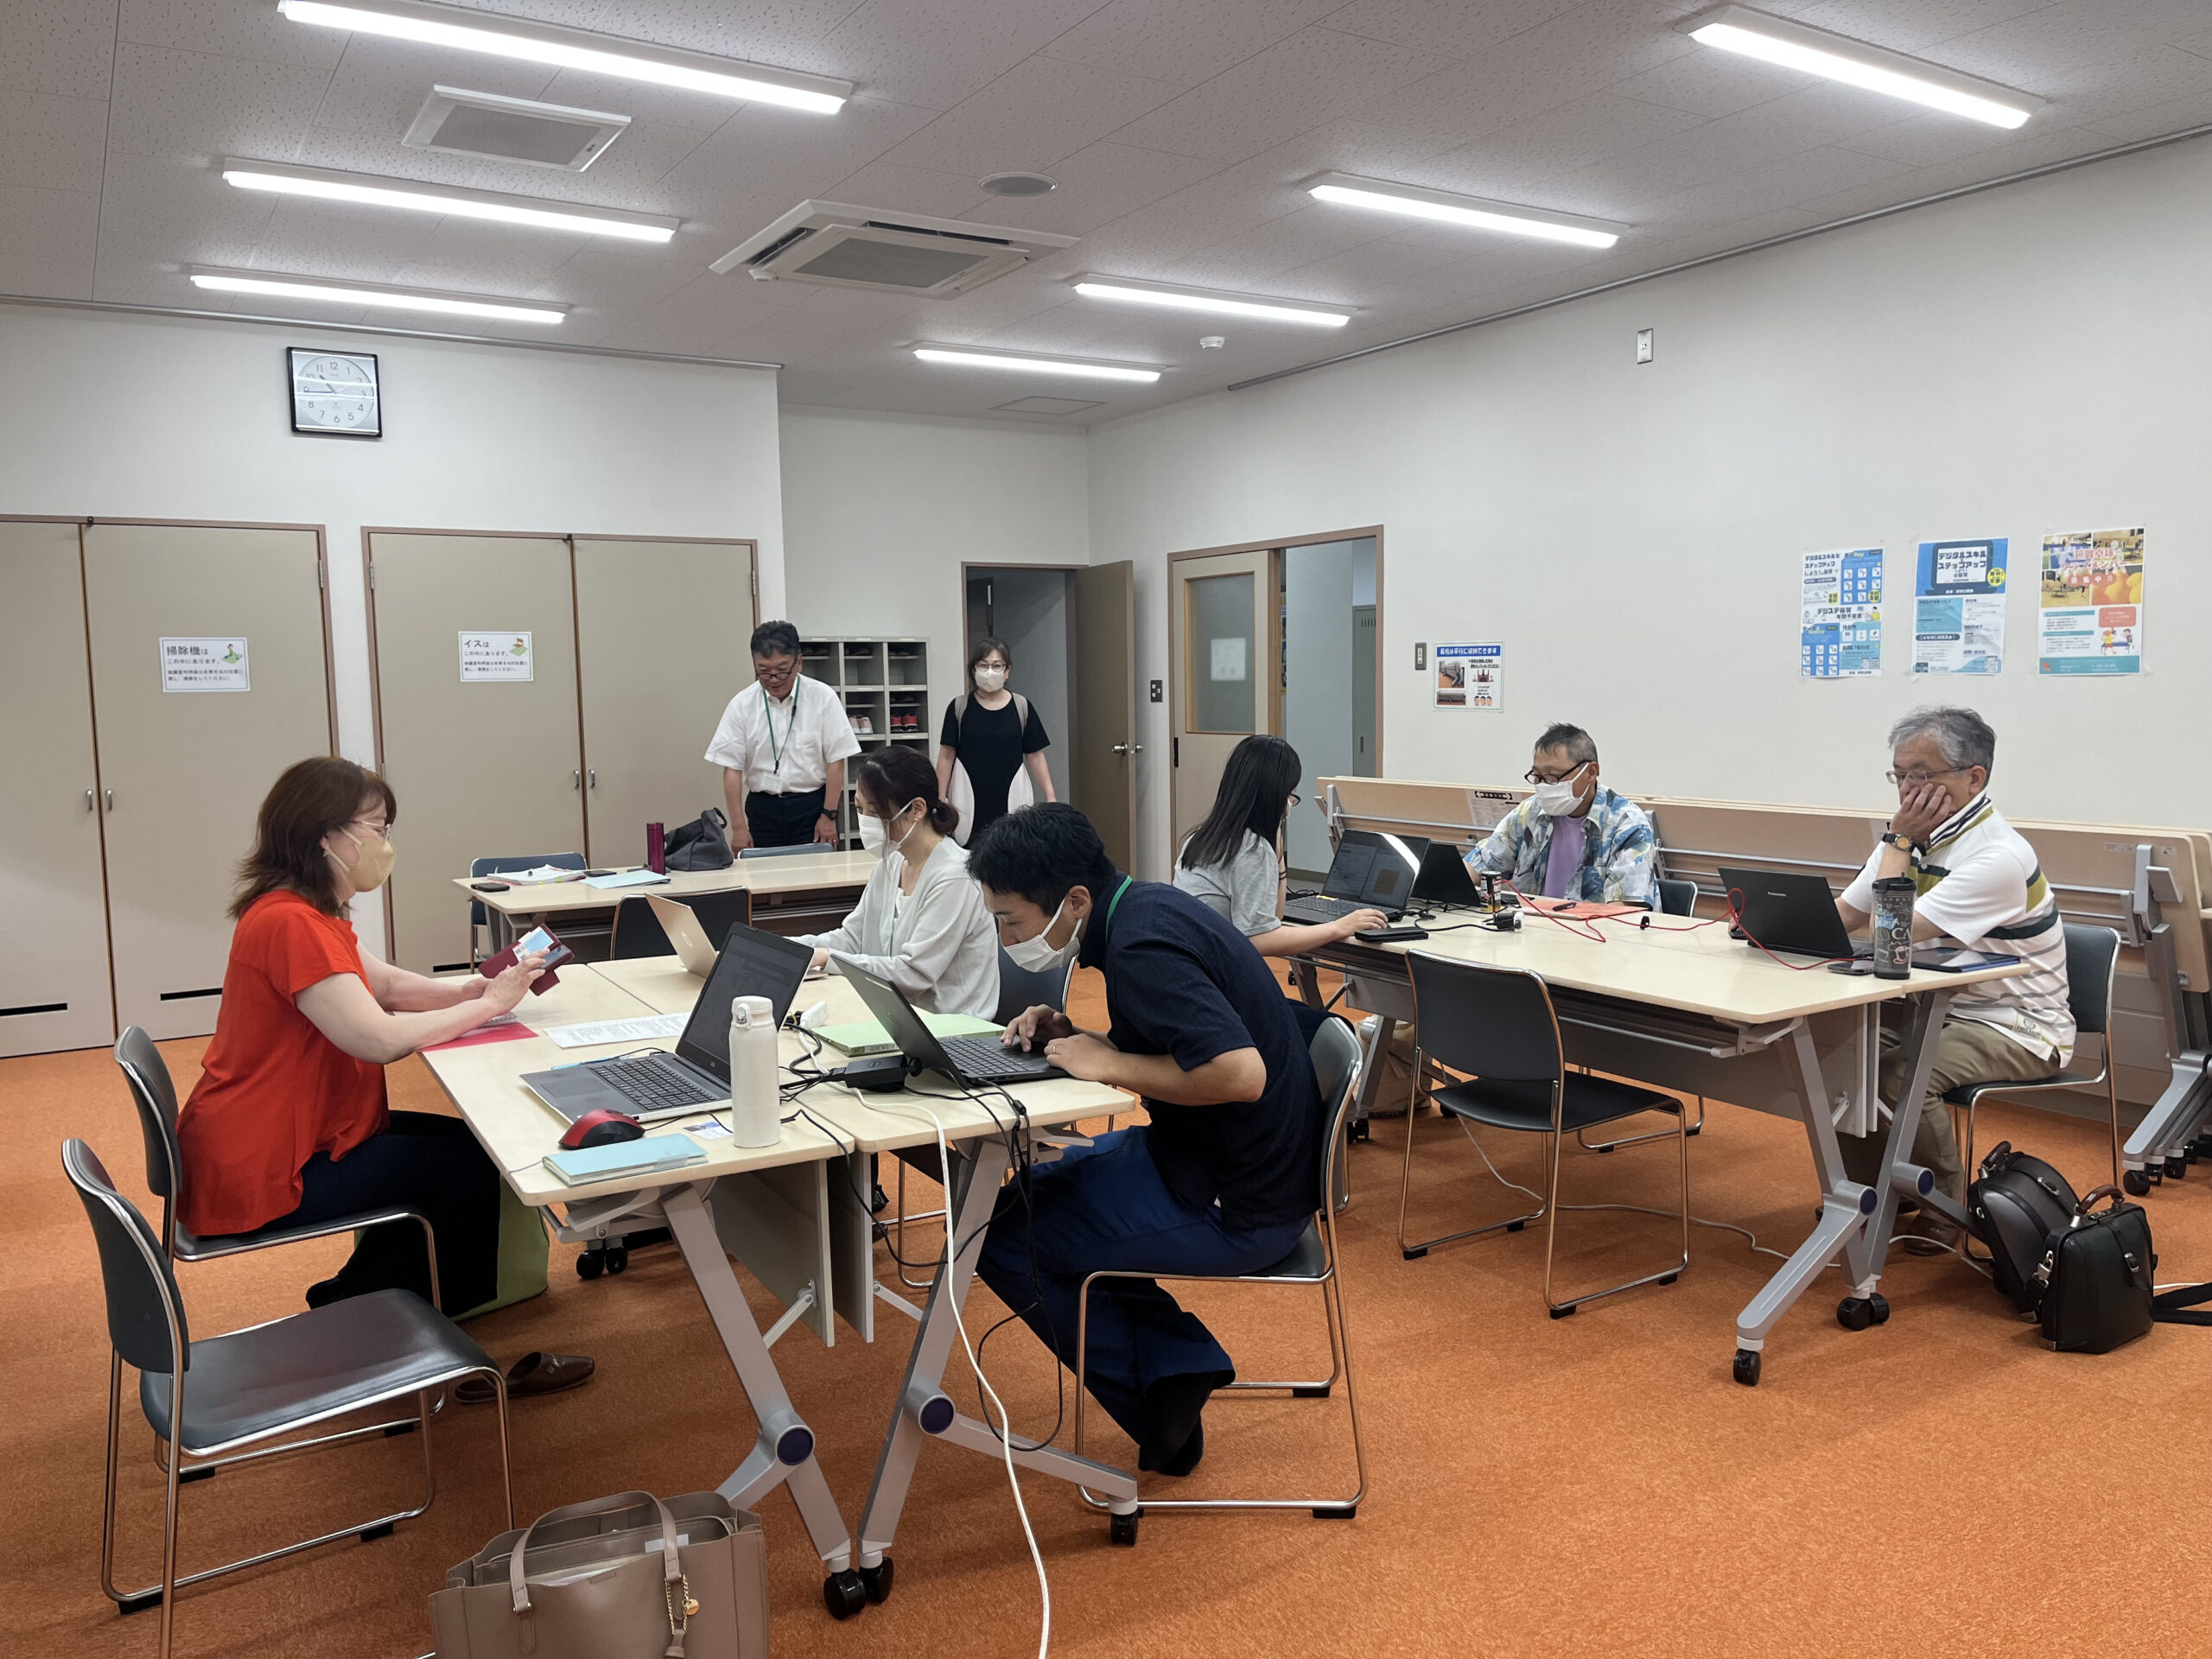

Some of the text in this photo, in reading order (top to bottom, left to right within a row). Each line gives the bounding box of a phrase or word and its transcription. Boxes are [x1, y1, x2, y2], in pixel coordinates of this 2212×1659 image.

[316, 364, 323, 372] 11
[329, 361, 339, 371] 12
[358, 404, 364, 412] 4
[320, 410, 325, 419] 7
[334, 415, 340, 423] 6
[347, 412, 354, 421] 5
[464, 639, 490, 648] イスは
[167, 645, 209, 656] 掃除機は
